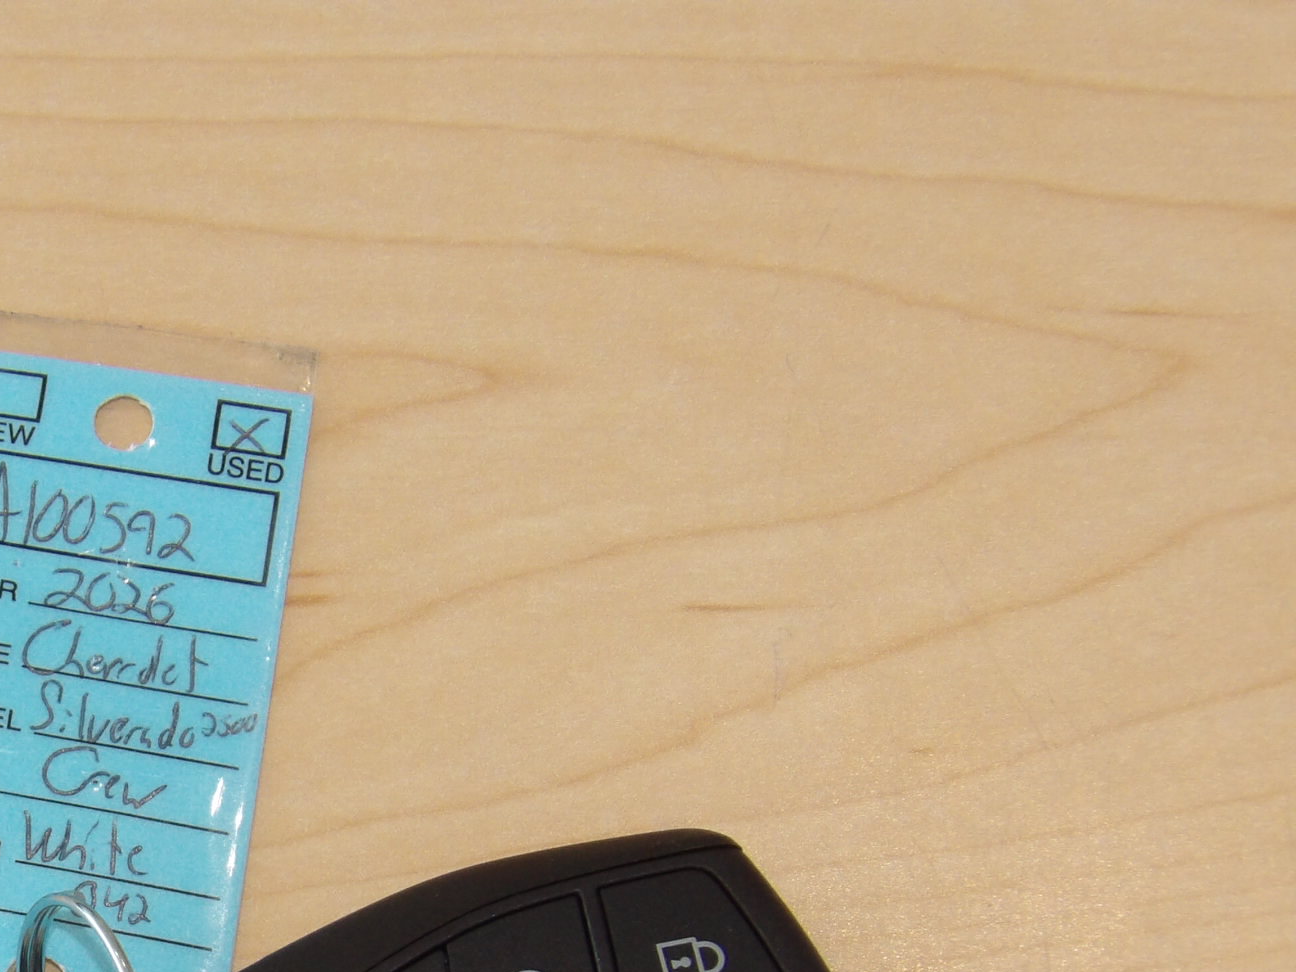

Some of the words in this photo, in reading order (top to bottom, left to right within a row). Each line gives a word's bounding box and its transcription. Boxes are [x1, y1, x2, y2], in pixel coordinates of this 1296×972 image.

[207, 453, 285, 484] USED
[44, 568, 175, 626] 2026
[42, 746, 168, 809] Crew
[24, 810, 148, 876] White
